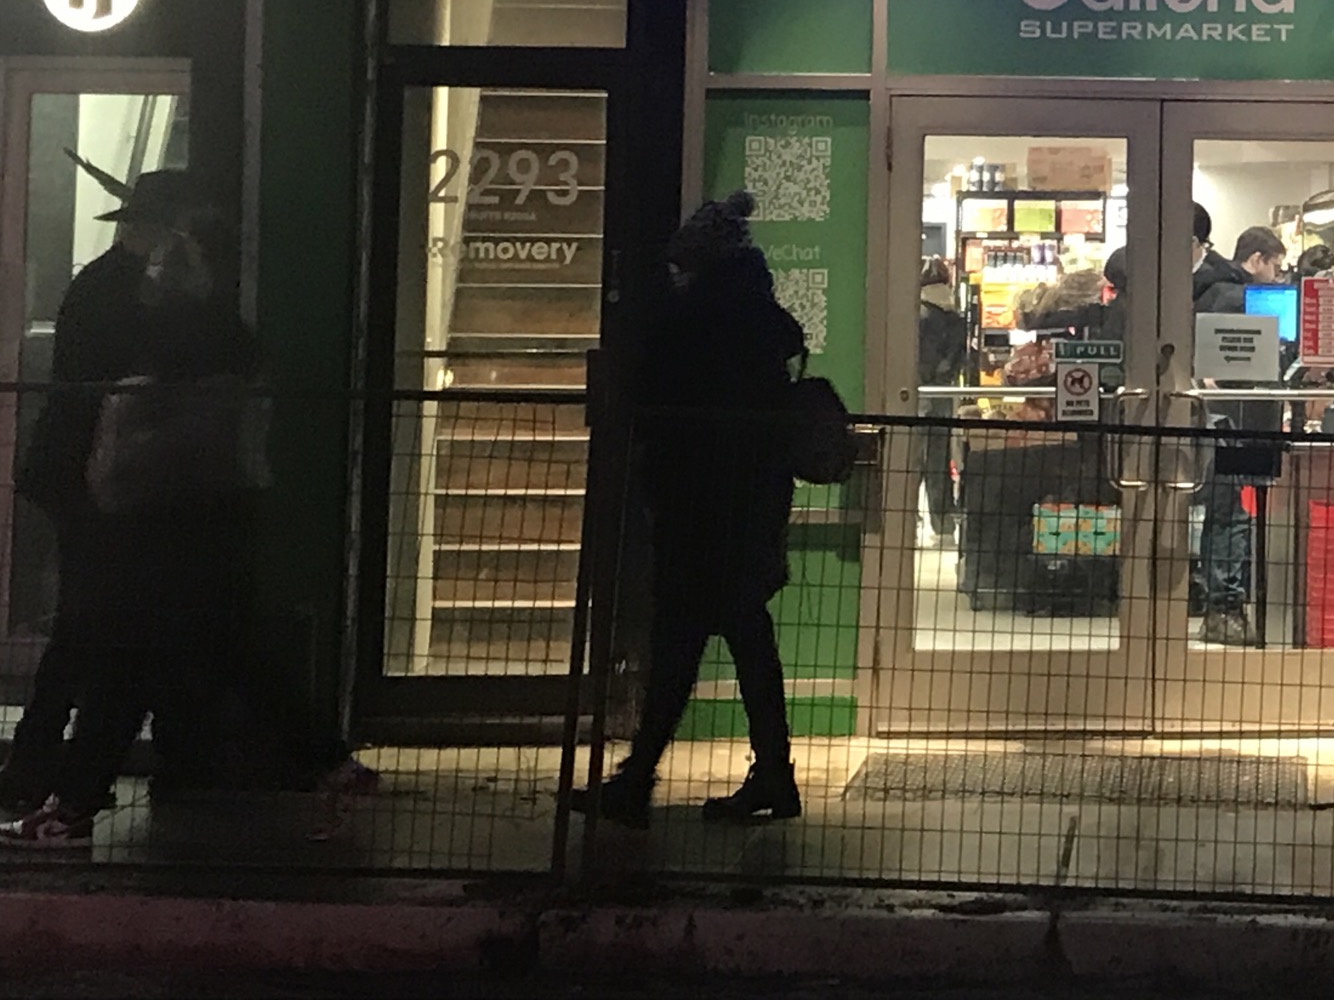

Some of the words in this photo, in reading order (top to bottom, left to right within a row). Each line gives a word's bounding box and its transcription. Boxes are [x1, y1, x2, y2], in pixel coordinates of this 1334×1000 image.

[1018, 20, 1295, 42] SUPERMARKET
[743, 112, 833, 135] Instagram
[427, 149, 580, 206] 2293
[427, 237, 580, 265] Removery
[1076, 345, 1117, 355] PULL
